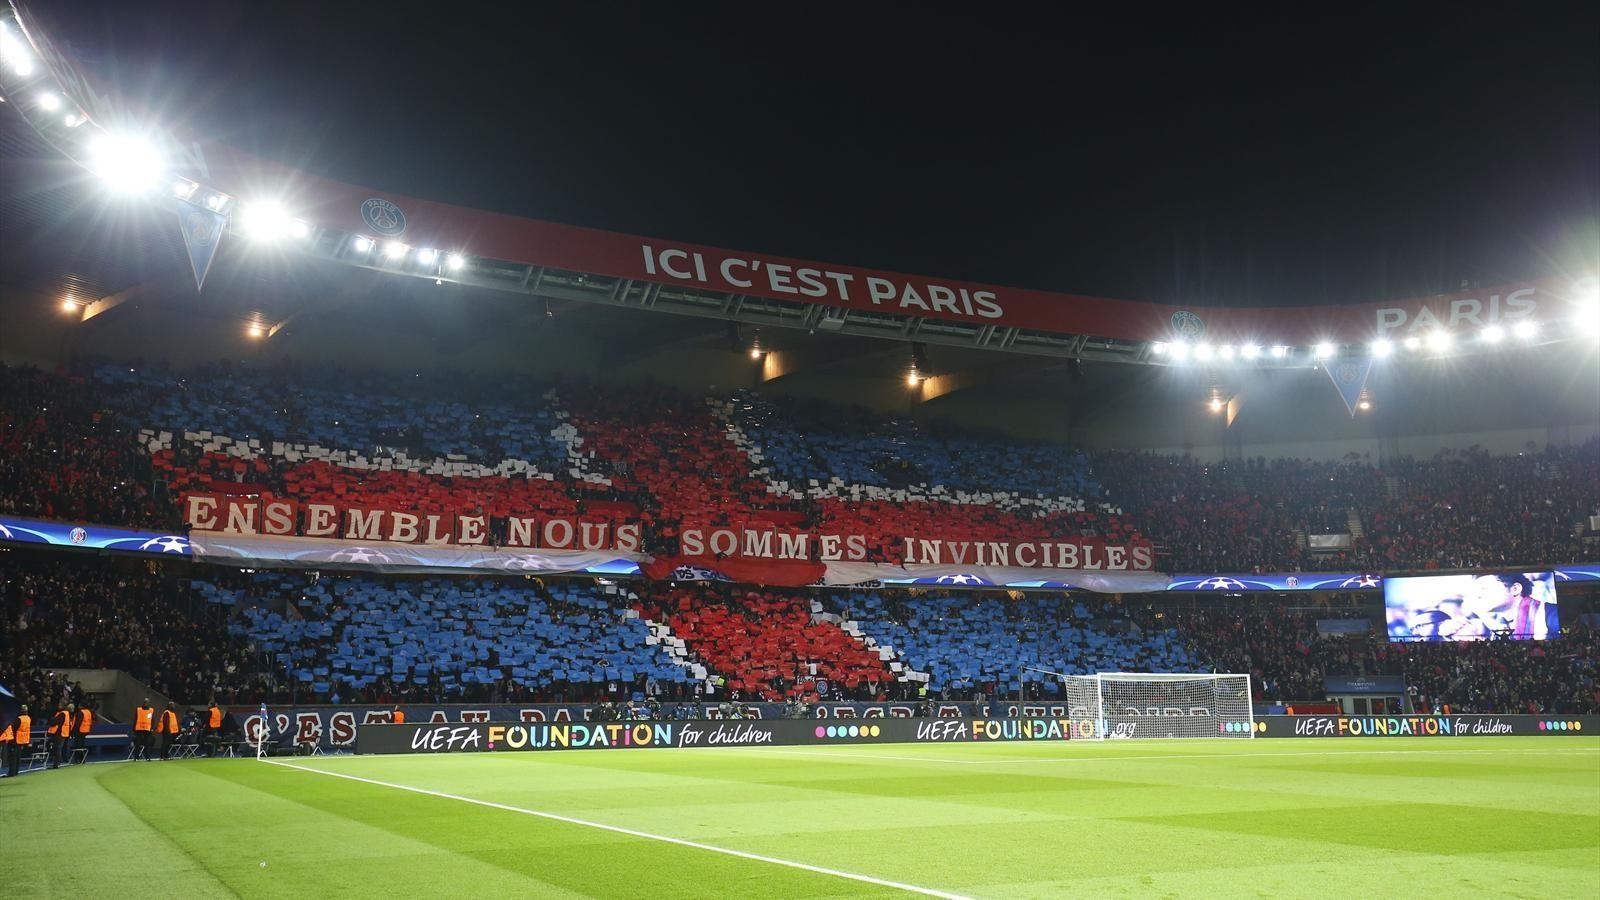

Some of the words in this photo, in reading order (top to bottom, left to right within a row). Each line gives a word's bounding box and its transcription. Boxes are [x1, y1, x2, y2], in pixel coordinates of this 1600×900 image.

[642, 245, 707, 282] ICI
[719, 260, 853, 300] C'EST
[867, 276, 1003, 318] PARIS
[1376, 288, 1537, 335] PARIS
[187, 496, 486, 545] ENSEMBLE
[508, 517, 640, 550] NOUS
[683, 528, 866, 560] SOMMES
[905, 538, 1153, 570] INVINCIBLES
[411, 726, 481, 750] UEFA
[488, 724, 671, 748] FOUNDATION
[678, 724, 703, 747] for
[708, 723, 772, 744] children
[917, 720, 968, 740] UEFA
[1295, 718, 1335, 735] UEFA
[1338, 717, 1450, 735] FOUNDATION
[1454, 718, 1469, 736] for
[1472, 718, 1512, 734] children
